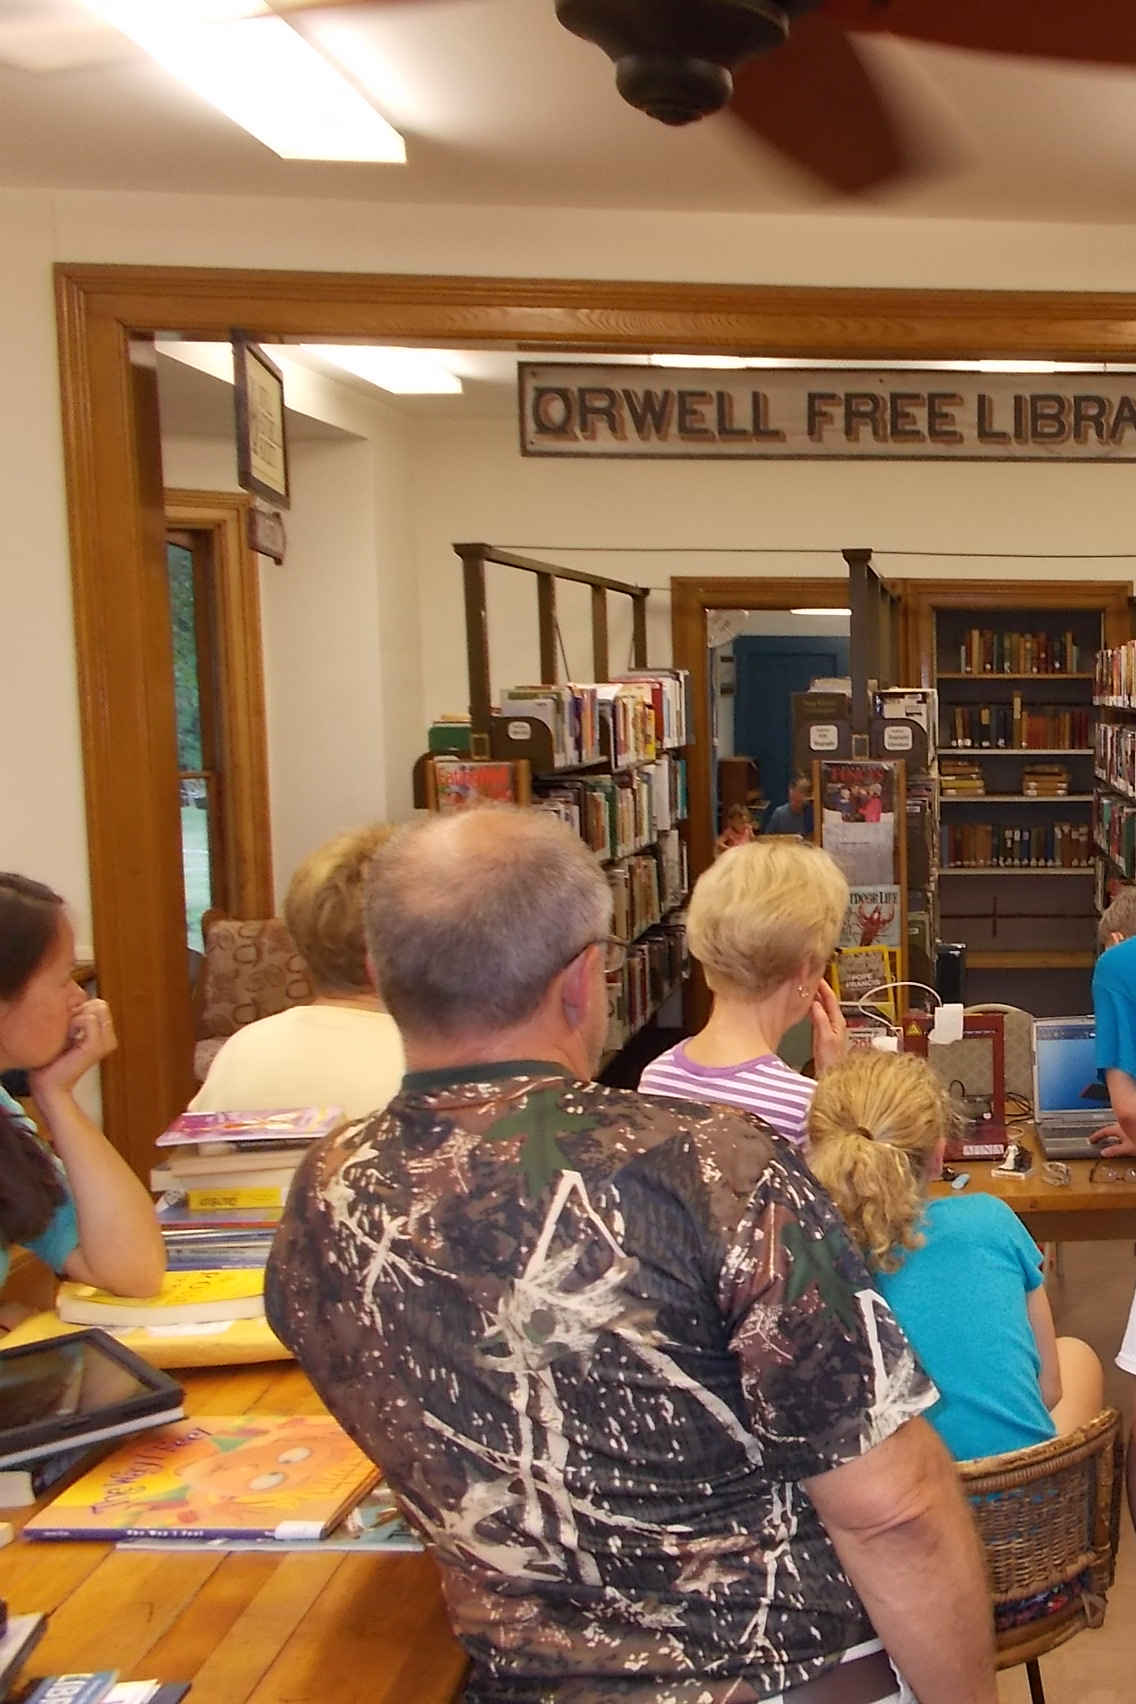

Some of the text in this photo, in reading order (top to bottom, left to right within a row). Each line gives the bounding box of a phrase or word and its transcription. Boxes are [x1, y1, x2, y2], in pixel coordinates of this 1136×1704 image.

[532, 386, 787, 443] ORWELL
[806, 390, 963, 444] FREE
[879, 890, 899, 905] LIFE
[845, 978, 881, 990] FRANCIS
[850, 973, 874, 982] POPE
[155, 1427, 214, 1453] Feel
[148, 1530, 169, 1538] Way
